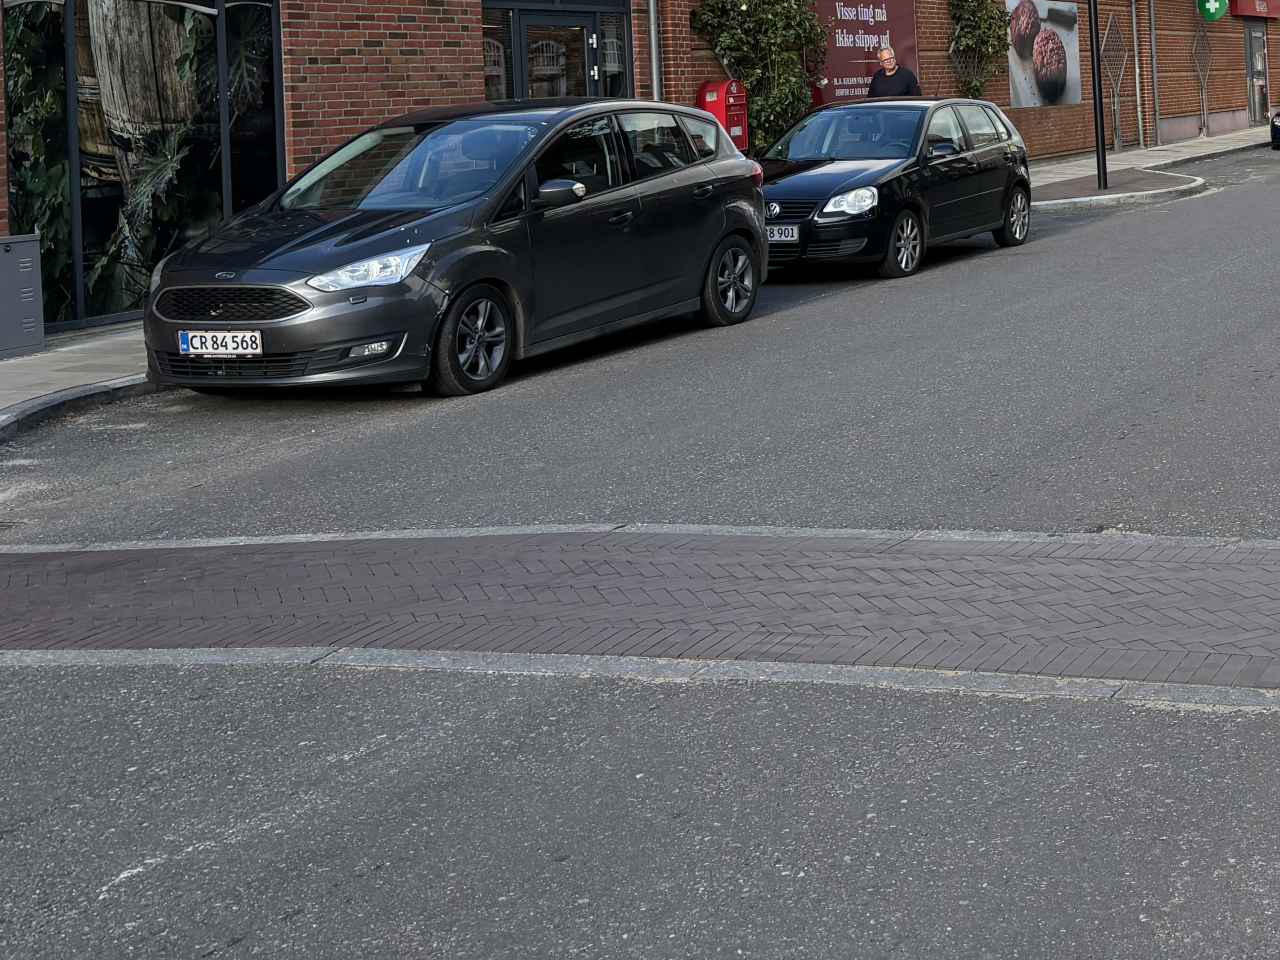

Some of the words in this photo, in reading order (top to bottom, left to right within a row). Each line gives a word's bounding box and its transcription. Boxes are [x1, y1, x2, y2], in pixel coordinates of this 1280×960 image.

[835, 1, 857, 20] Visse
[858, 3, 874, 26] ting
[875, 3, 887, 21] må
[835, 29, 854, 47] ikke
[777, 227, 795, 239] 901
[190, 335, 208, 350] CR
[211, 335, 228, 350] 84
[231, 334, 259, 350] 568
